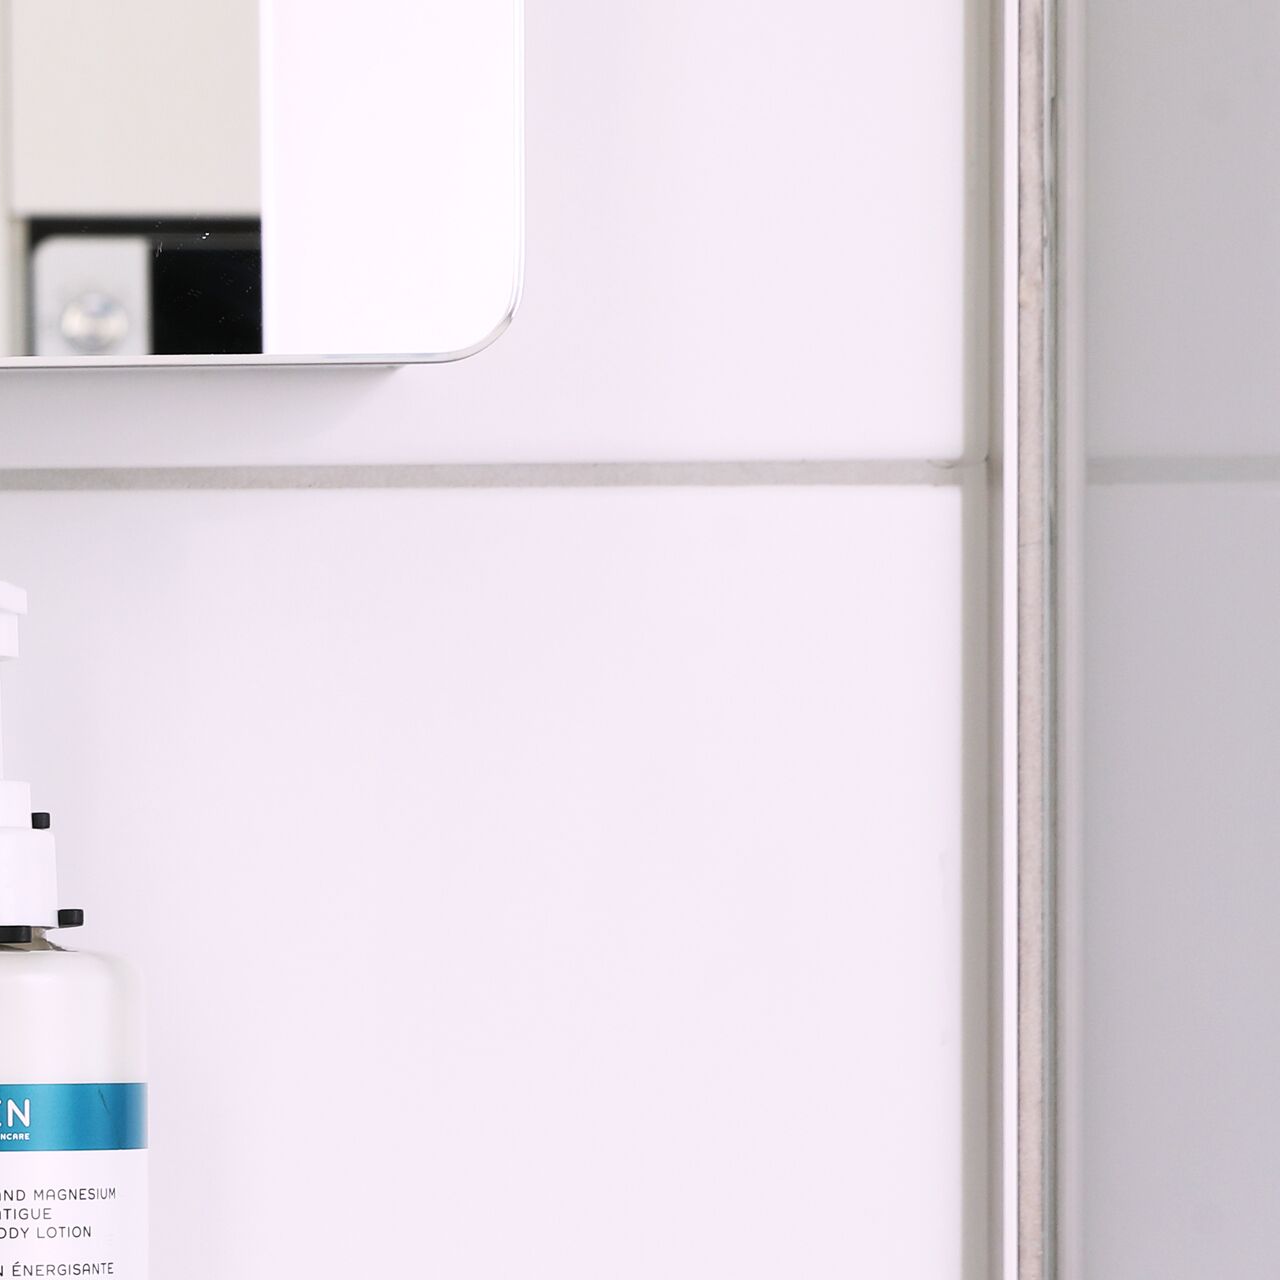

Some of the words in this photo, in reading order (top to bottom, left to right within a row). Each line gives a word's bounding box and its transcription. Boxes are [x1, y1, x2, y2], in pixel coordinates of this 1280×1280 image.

[32, 1187, 117, 1202] MAGNESIUM
[36, 1226, 92, 1239] LOTION
[11, 1261, 115, 1277] ÉNERGISANTE
